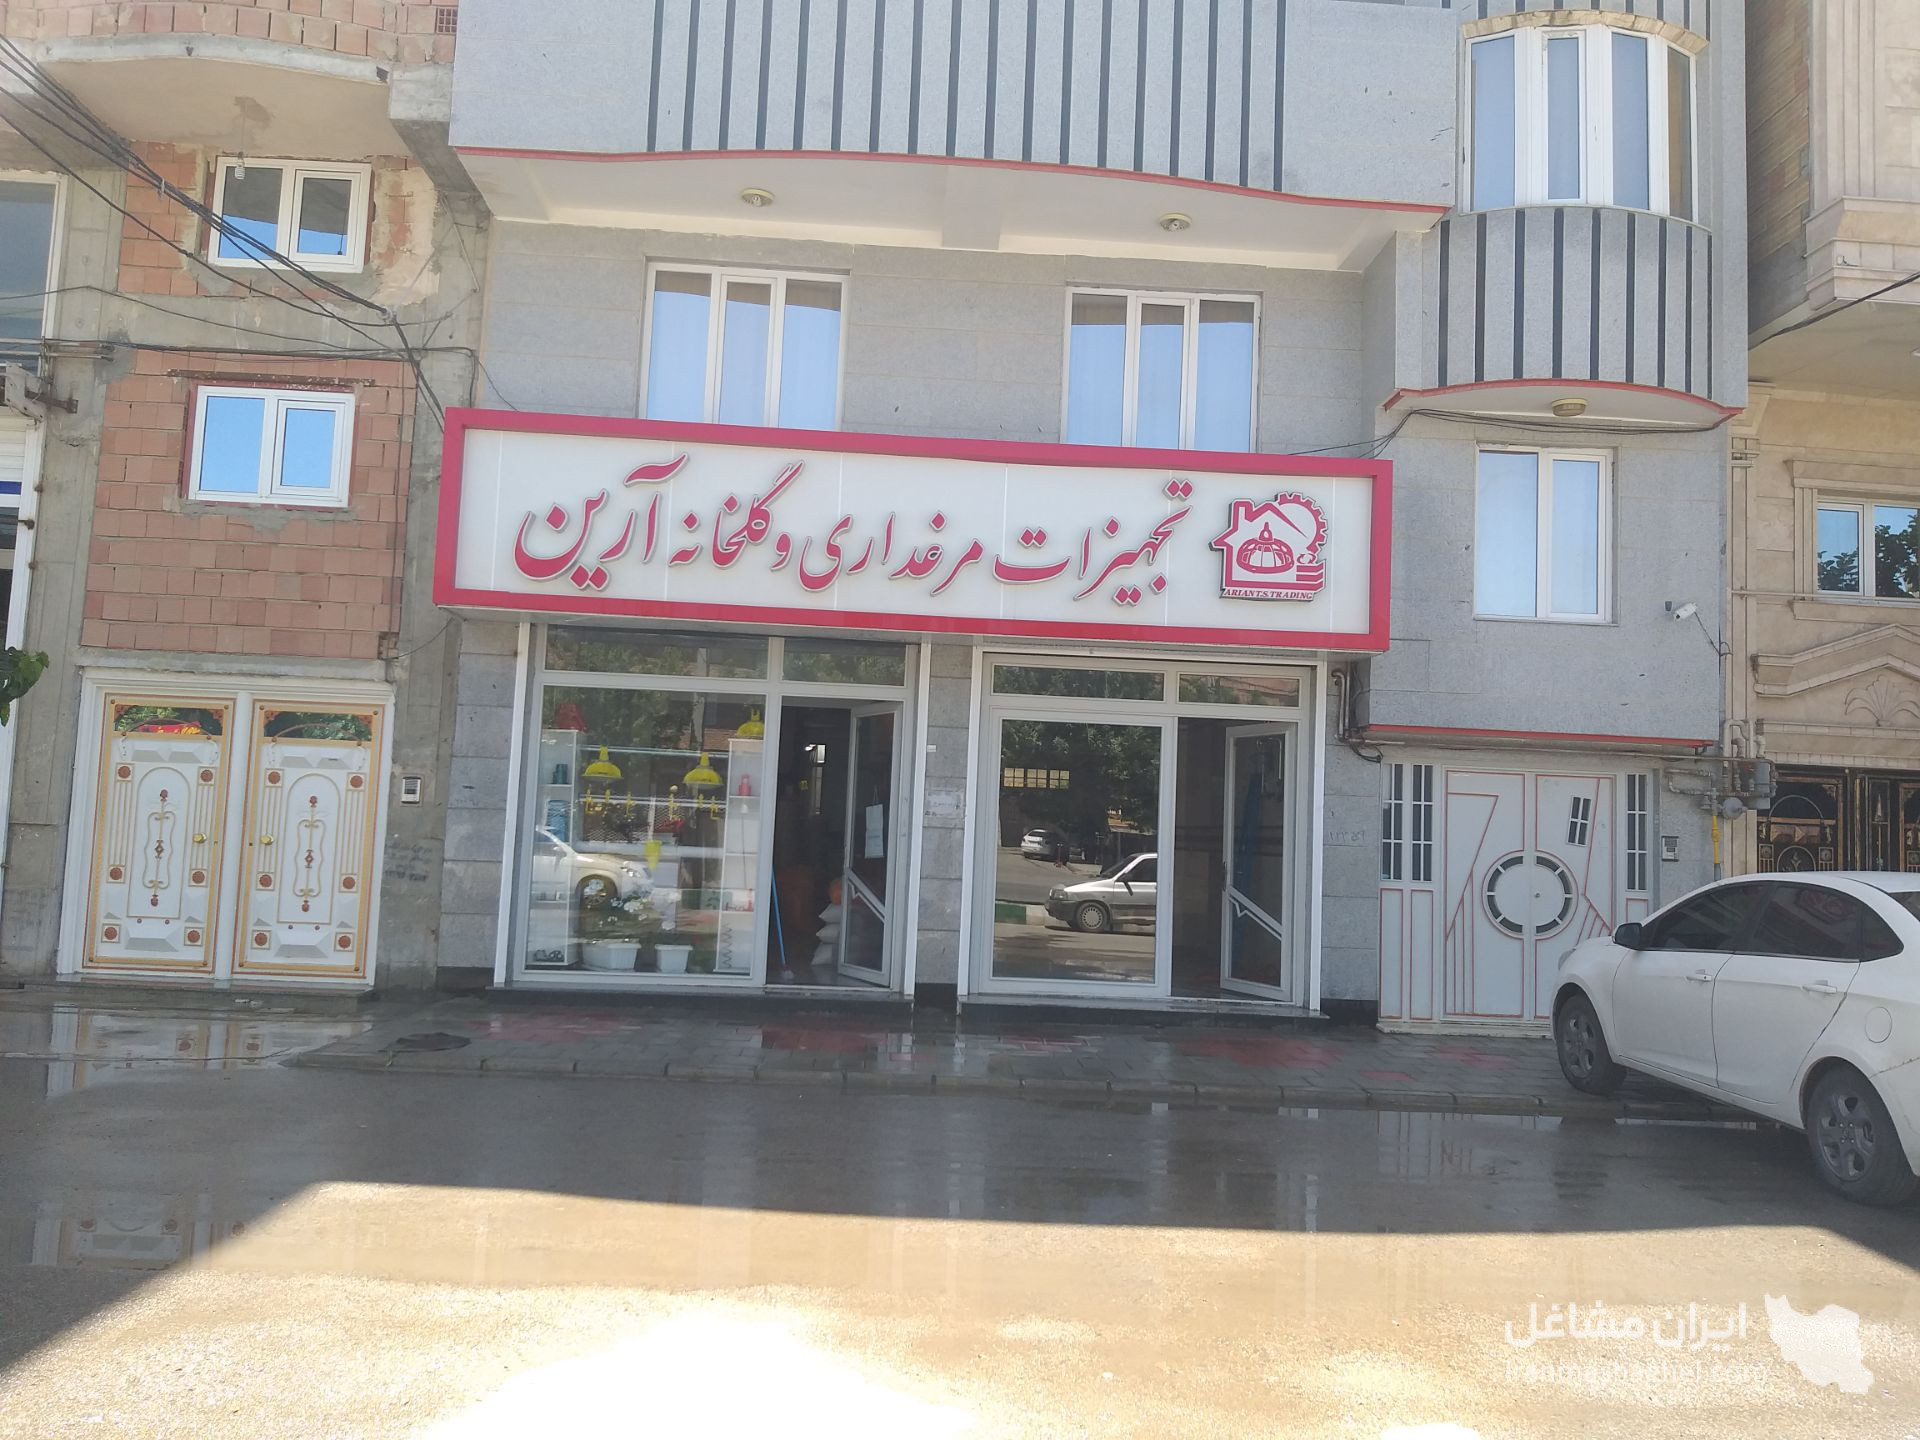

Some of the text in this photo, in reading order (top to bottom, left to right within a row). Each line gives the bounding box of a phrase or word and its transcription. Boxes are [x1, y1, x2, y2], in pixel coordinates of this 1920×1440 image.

[512, 452, 1194, 605] تجهیزات مرغداری و گلخانه آرین
